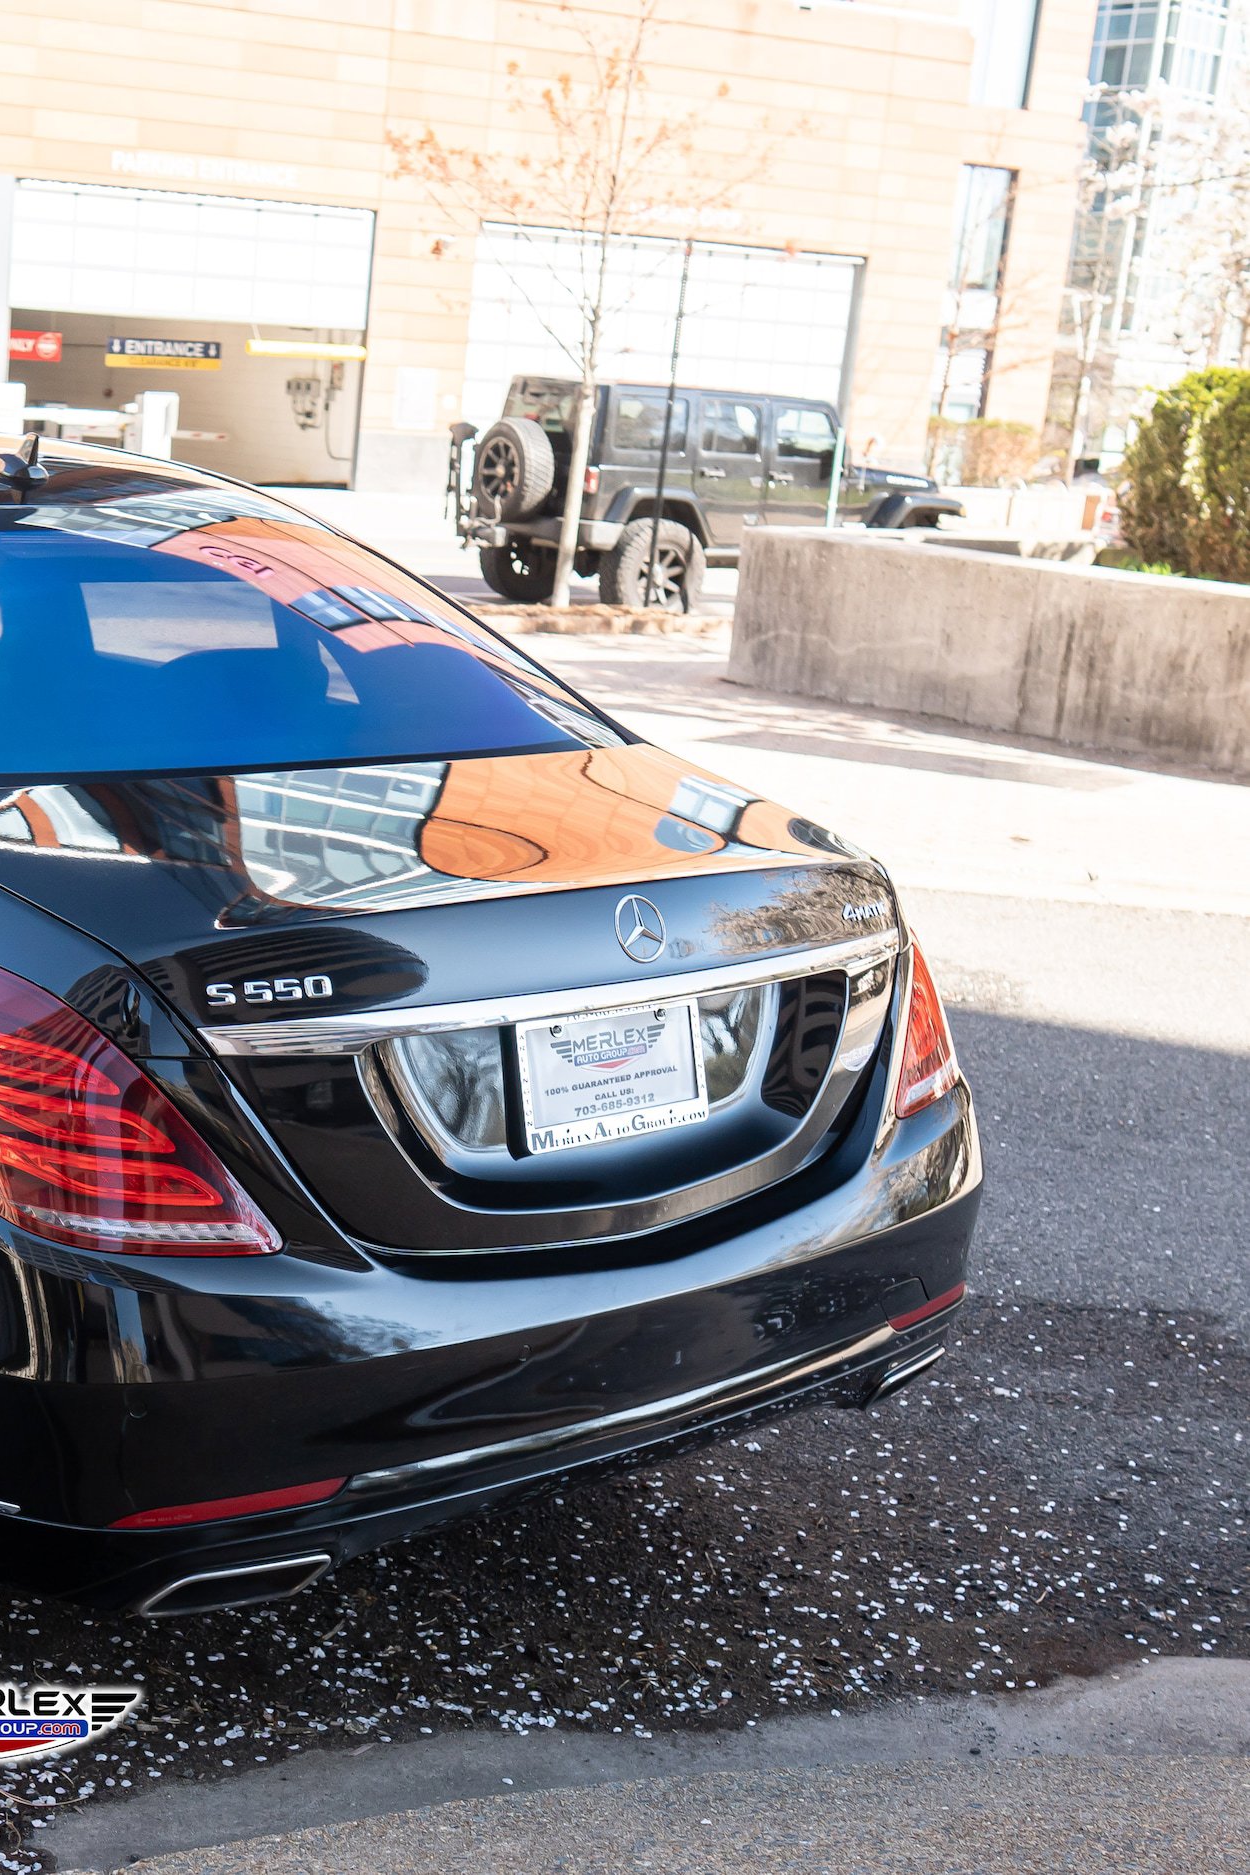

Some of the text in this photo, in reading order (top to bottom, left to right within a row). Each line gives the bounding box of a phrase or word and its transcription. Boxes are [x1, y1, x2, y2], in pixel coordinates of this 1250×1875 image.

[124, 339, 206, 357] ENTRANCE
[206, 975, 333, 1007] S 550
[572, 1028, 647, 1054] MERLEX
[576, 1053, 600, 1064] AUTO
[544, 1065, 678, 1097] 100% GUARANTEED APPROVAL
[574, 1093, 655, 1118] 703-685-9312
[594, 1091, 617, 1101] CALL
